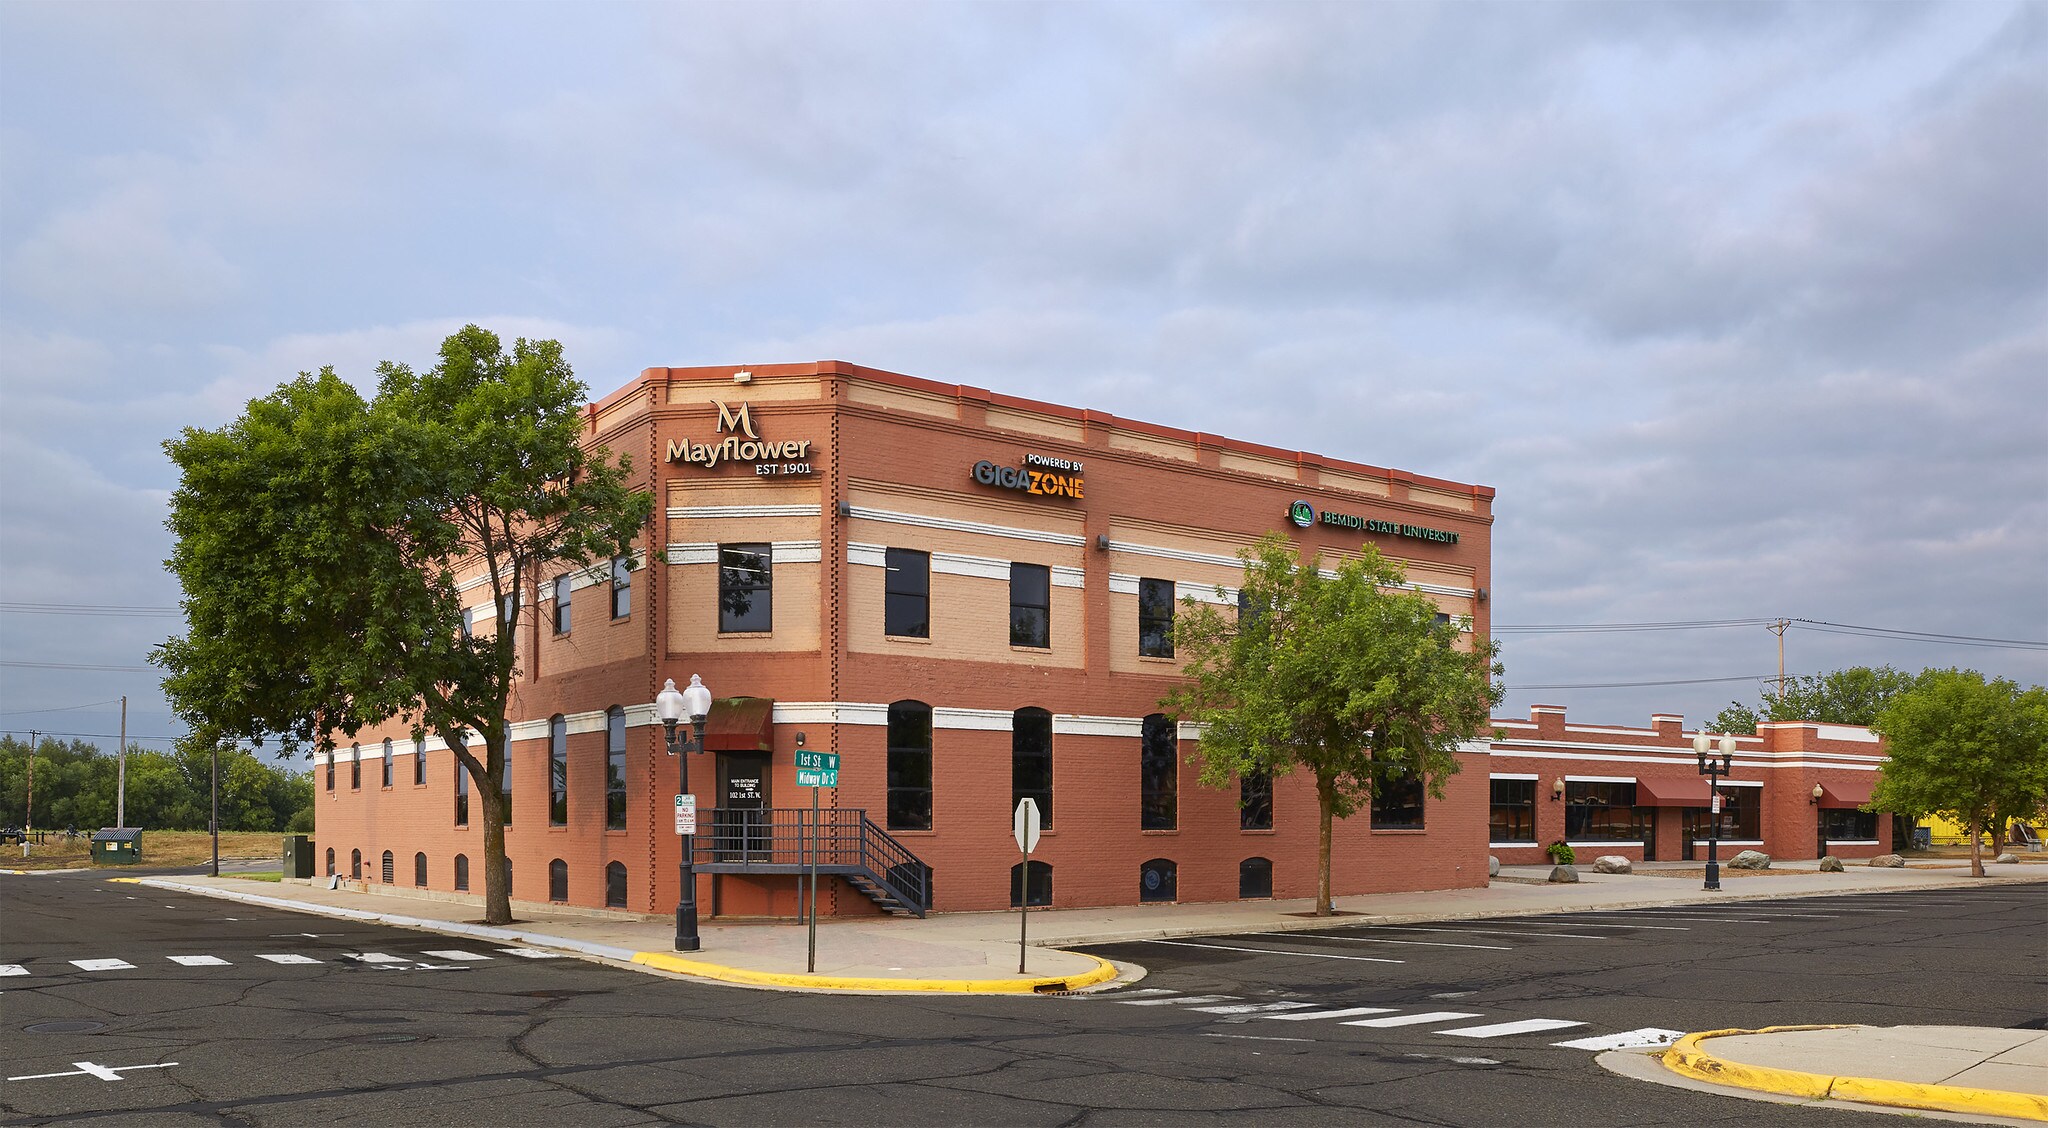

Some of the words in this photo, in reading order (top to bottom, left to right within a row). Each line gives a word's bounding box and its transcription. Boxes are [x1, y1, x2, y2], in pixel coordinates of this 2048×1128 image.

[665, 437, 811, 468] Mayflower
[756, 464, 778, 475] EST
[783, 463, 811, 474] 1901
[1028, 453, 1071, 469] POWERED
[1073, 461, 1083, 471] BY
[1324, 511, 1367, 530] BEMIDJI
[1369, 519, 1399, 535] STATE
[1403, 524, 1460, 544] UNIVERSITY
[800, 753, 810, 766] 1st
[813, 754, 821, 767] St
[829, 756, 836, 768] W
[799, 771, 820, 787] Midway
[821, 772, 829, 785] Dr
[830, 772, 835, 785] S
[676, 796, 682, 805] 2
